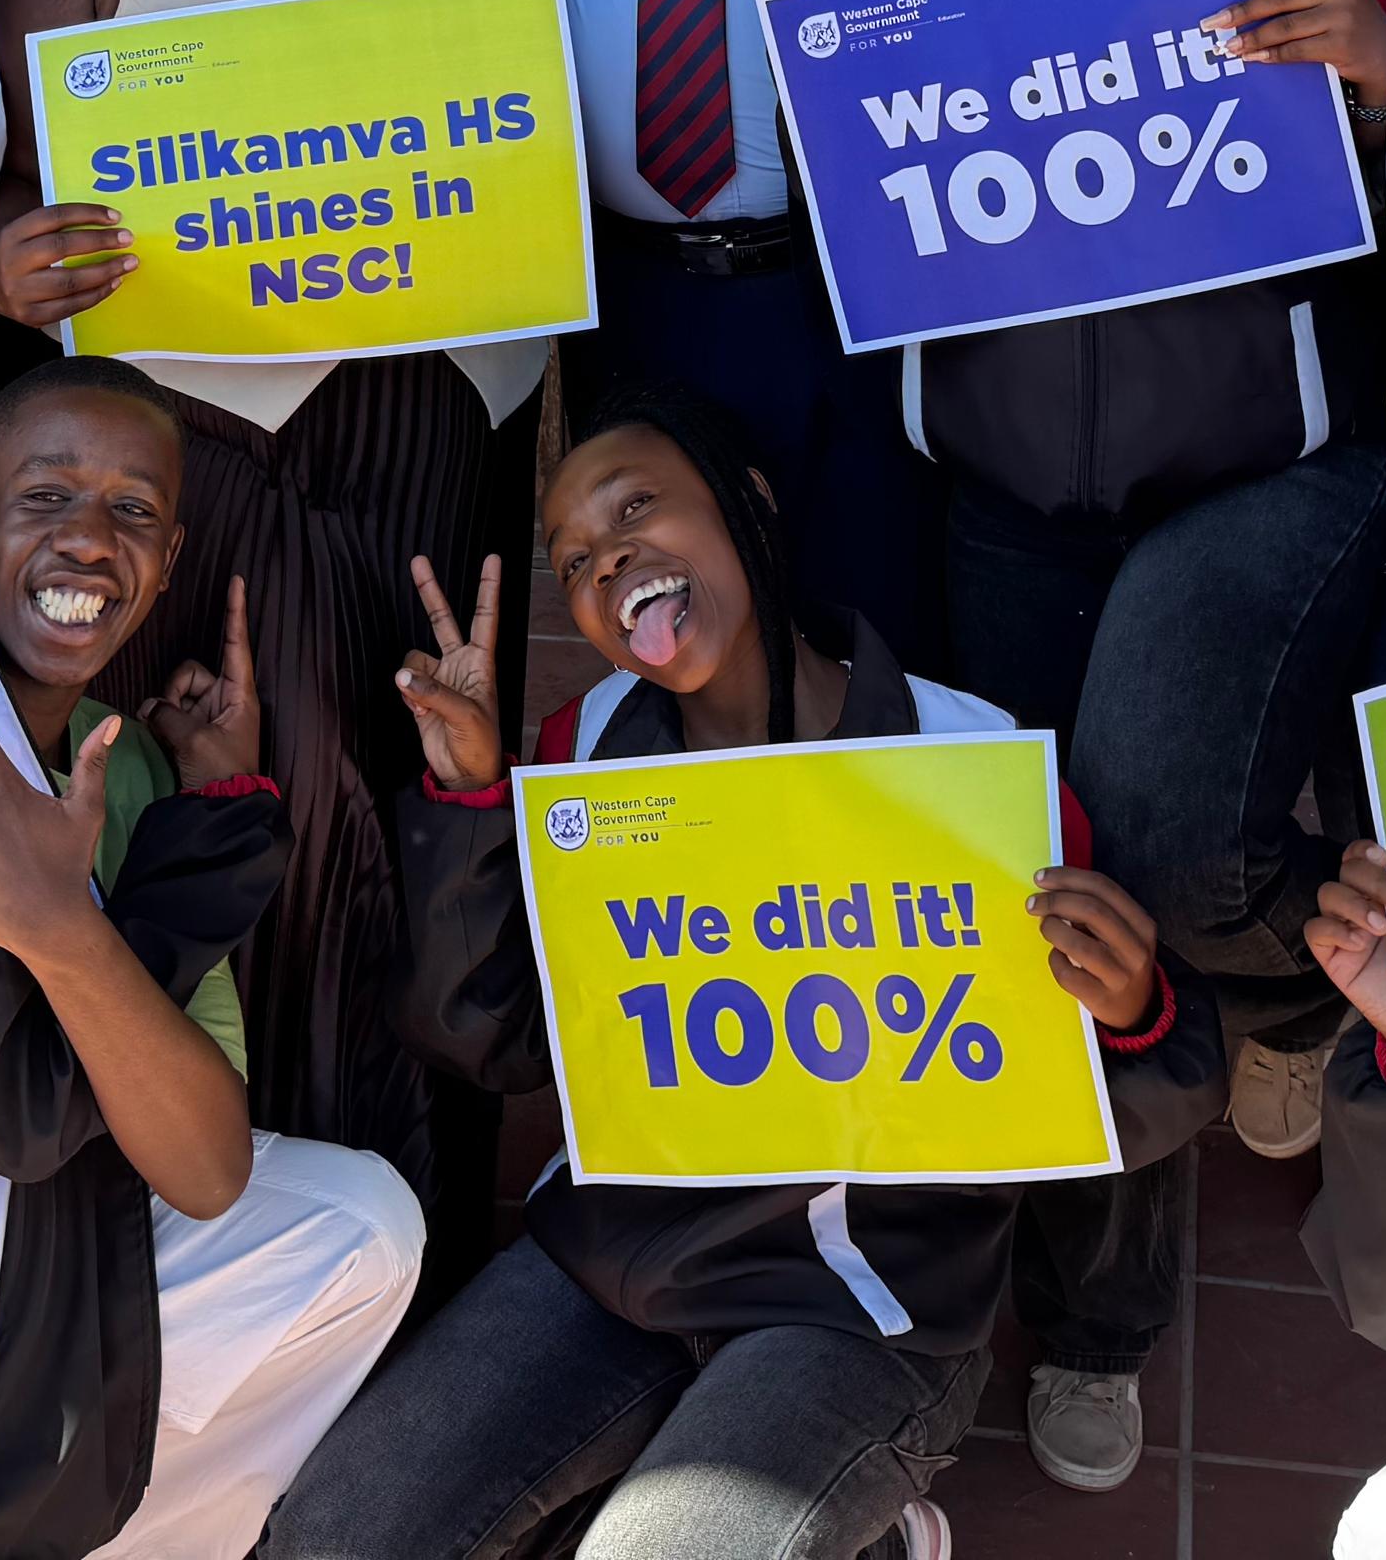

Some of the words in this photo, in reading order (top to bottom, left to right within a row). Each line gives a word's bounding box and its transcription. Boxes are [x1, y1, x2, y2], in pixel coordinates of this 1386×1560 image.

[842, 2, 893, 21] Western
[845, 10, 920, 34] Government
[115, 45, 167, 61] Western
[172, 41, 204, 54] Cape
[849, 39, 877, 52] FOR
[883, 30, 913, 45] YOU
[117, 55, 194, 74] Government
[155, 74, 184, 86] YOU
[861, 83, 989, 150] We
[1010, 41, 1139, 122] did
[1152, 27, 1246, 90] it!
[91, 116, 426, 194] Silikamva
[444, 92, 537, 148] HS
[880, 98, 1268, 257] 100%
[173, 187, 394, 252] shines
[414, 171, 474, 220] in
[249, 243, 414, 307] NSC!
[591, 799, 641, 812] Western
[645, 795, 676, 807] Cape
[594, 810, 668, 826] Government
[631, 832, 659, 844] YOU
[605, 894, 732, 960] We
[753, 883, 876, 951] did
[892, 881, 981, 948] it!
[617, 972, 1004, 1089] 100%
